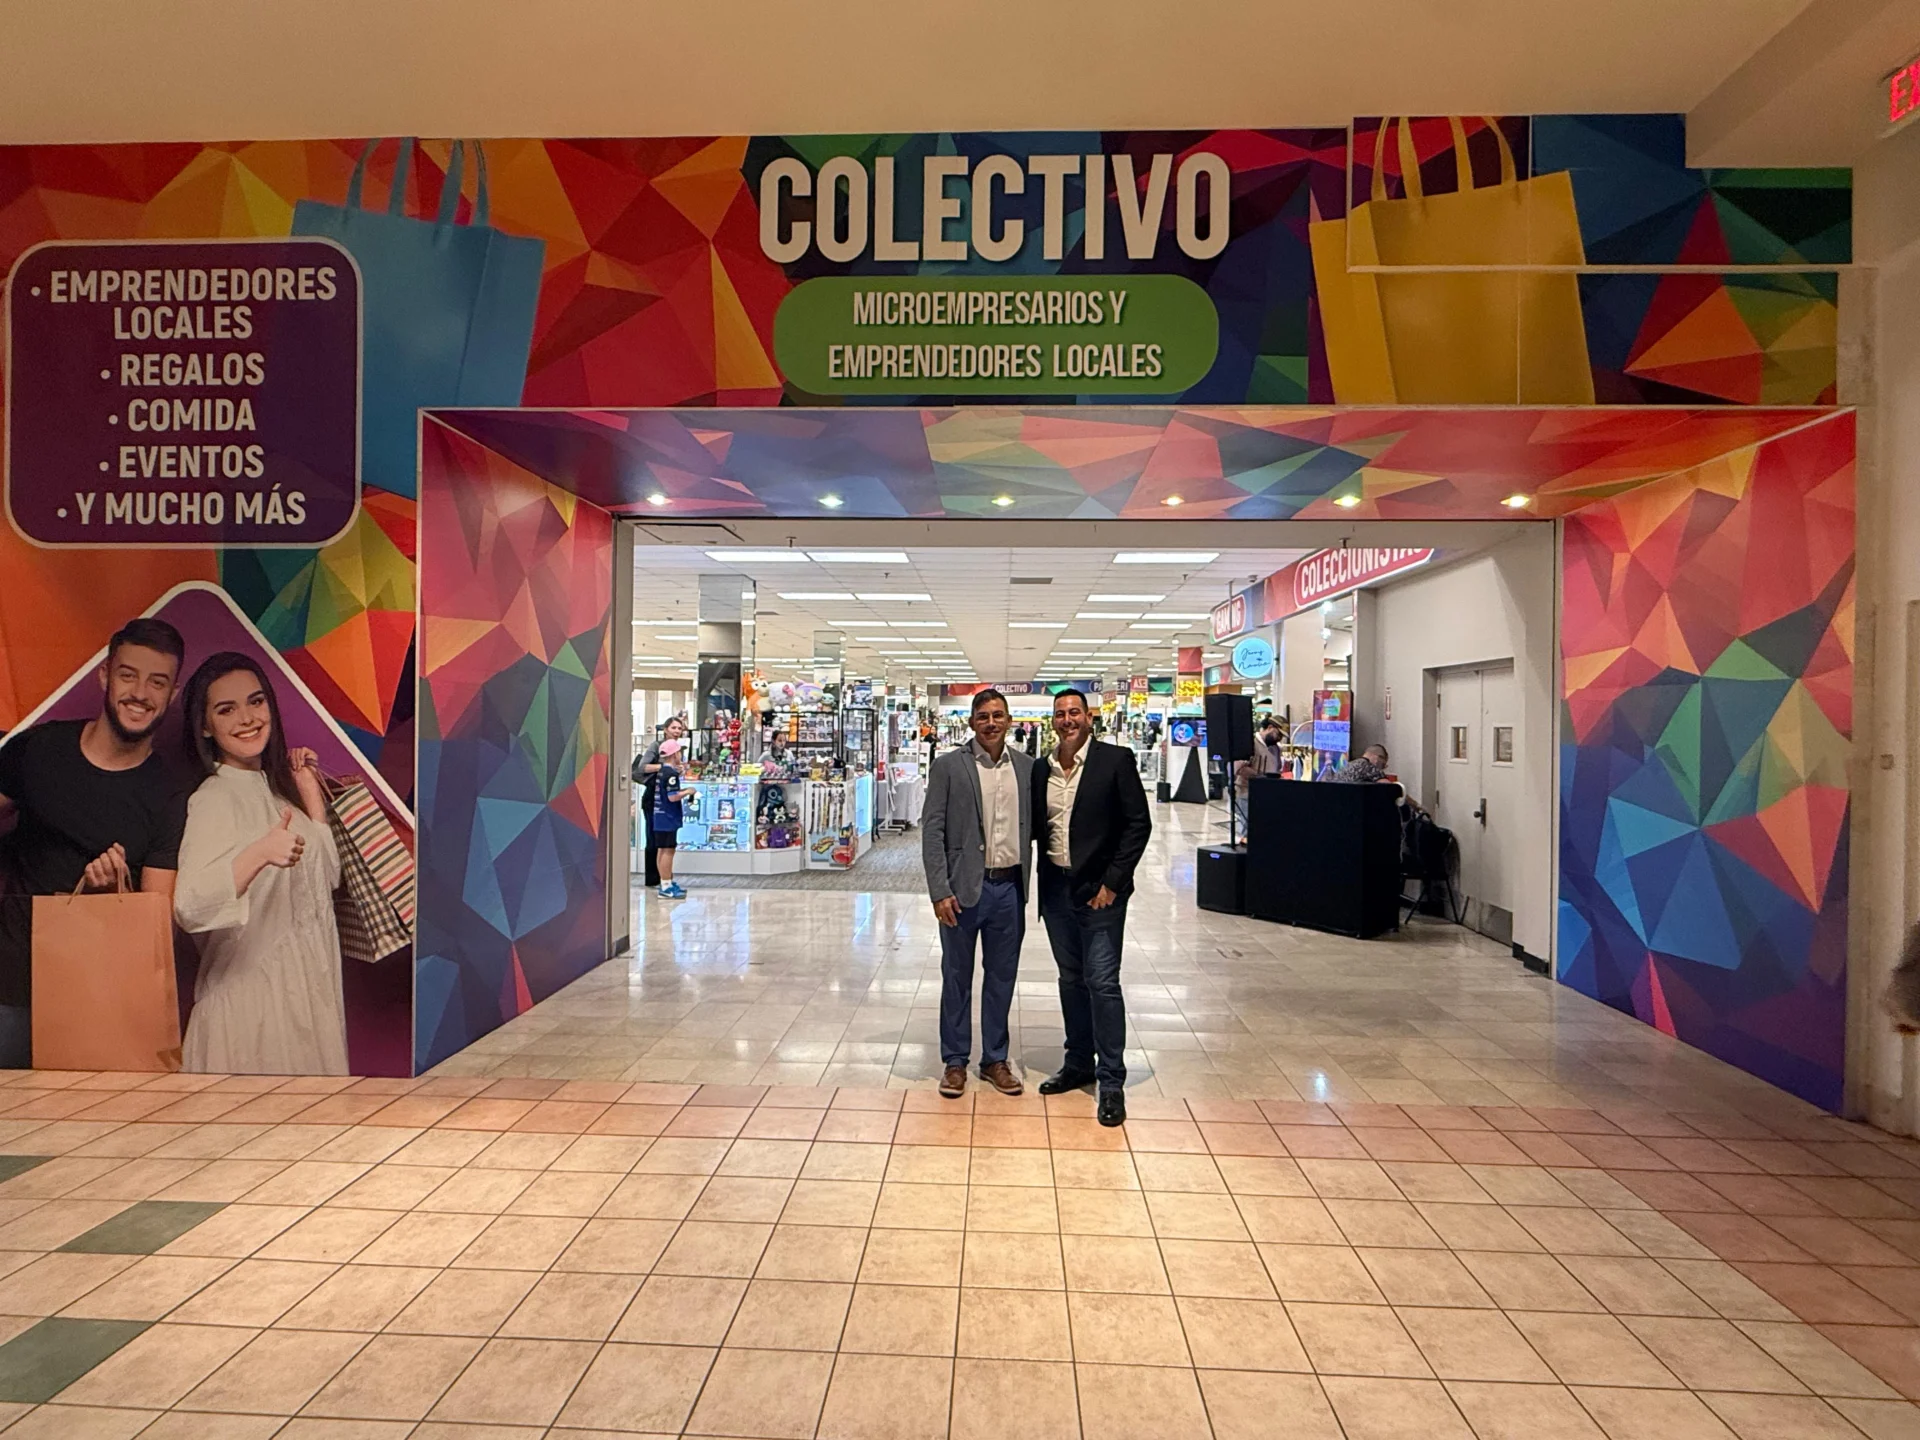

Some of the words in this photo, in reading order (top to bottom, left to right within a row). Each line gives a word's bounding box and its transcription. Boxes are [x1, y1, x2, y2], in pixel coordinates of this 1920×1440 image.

[759, 151, 1231, 264] COLECTIVO
[50, 267, 337, 303] EMPRENDEDORES
[114, 305, 253, 340] LOCALES
[853, 291, 1103, 326] MICROEMPRESARIOS
[1108, 290, 1126, 324] Y
[120, 353, 265, 386] REGALOS
[828, 344, 1042, 378] EMPRENDEDORES
[1052, 343, 1163, 377] LOCALES
[128, 398, 256, 432] COMIDA
[119, 445, 265, 478] EVENTOS
[75, 492, 96, 525] Y
[105, 492, 225, 525] MUCHO
[235, 483, 306, 525] MÁS
[995, 684, 1028, 693] COLECTIVO
